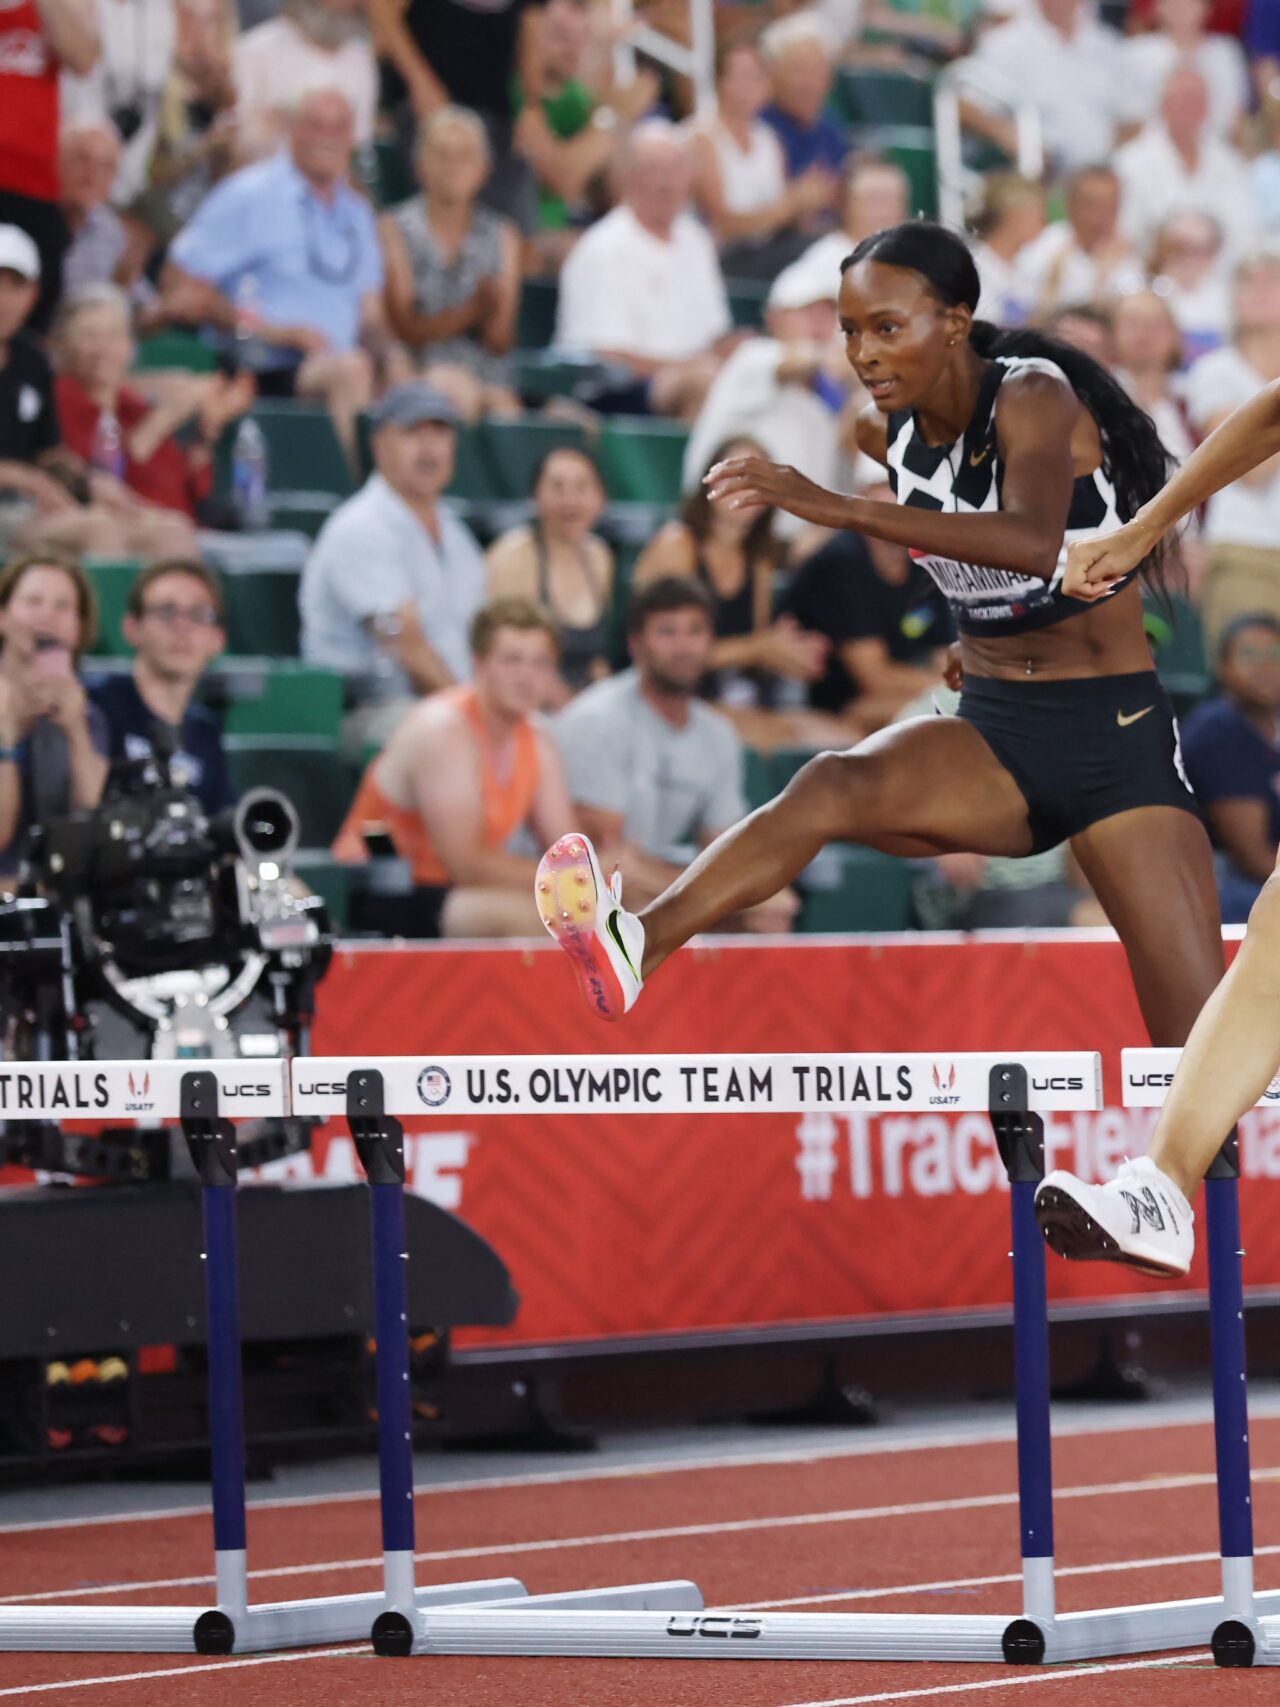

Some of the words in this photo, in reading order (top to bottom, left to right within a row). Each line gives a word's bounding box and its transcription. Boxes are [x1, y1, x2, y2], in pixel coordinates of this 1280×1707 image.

[0, 1073, 110, 1109] TRIALS
[222, 1084, 272, 1097] UCS
[298, 1082, 347, 1096] UCS
[466, 1068, 520, 1104] U.S.
[528, 1067, 663, 1104] OLYMPIC
[679, 1066, 773, 1103] TEAM
[791, 1064, 913, 1102] TRIALS
[1031, 1077, 1084, 1091] UCS
[929, 1095, 961, 1105] USATF
[666, 1616, 762, 1639] UCS
